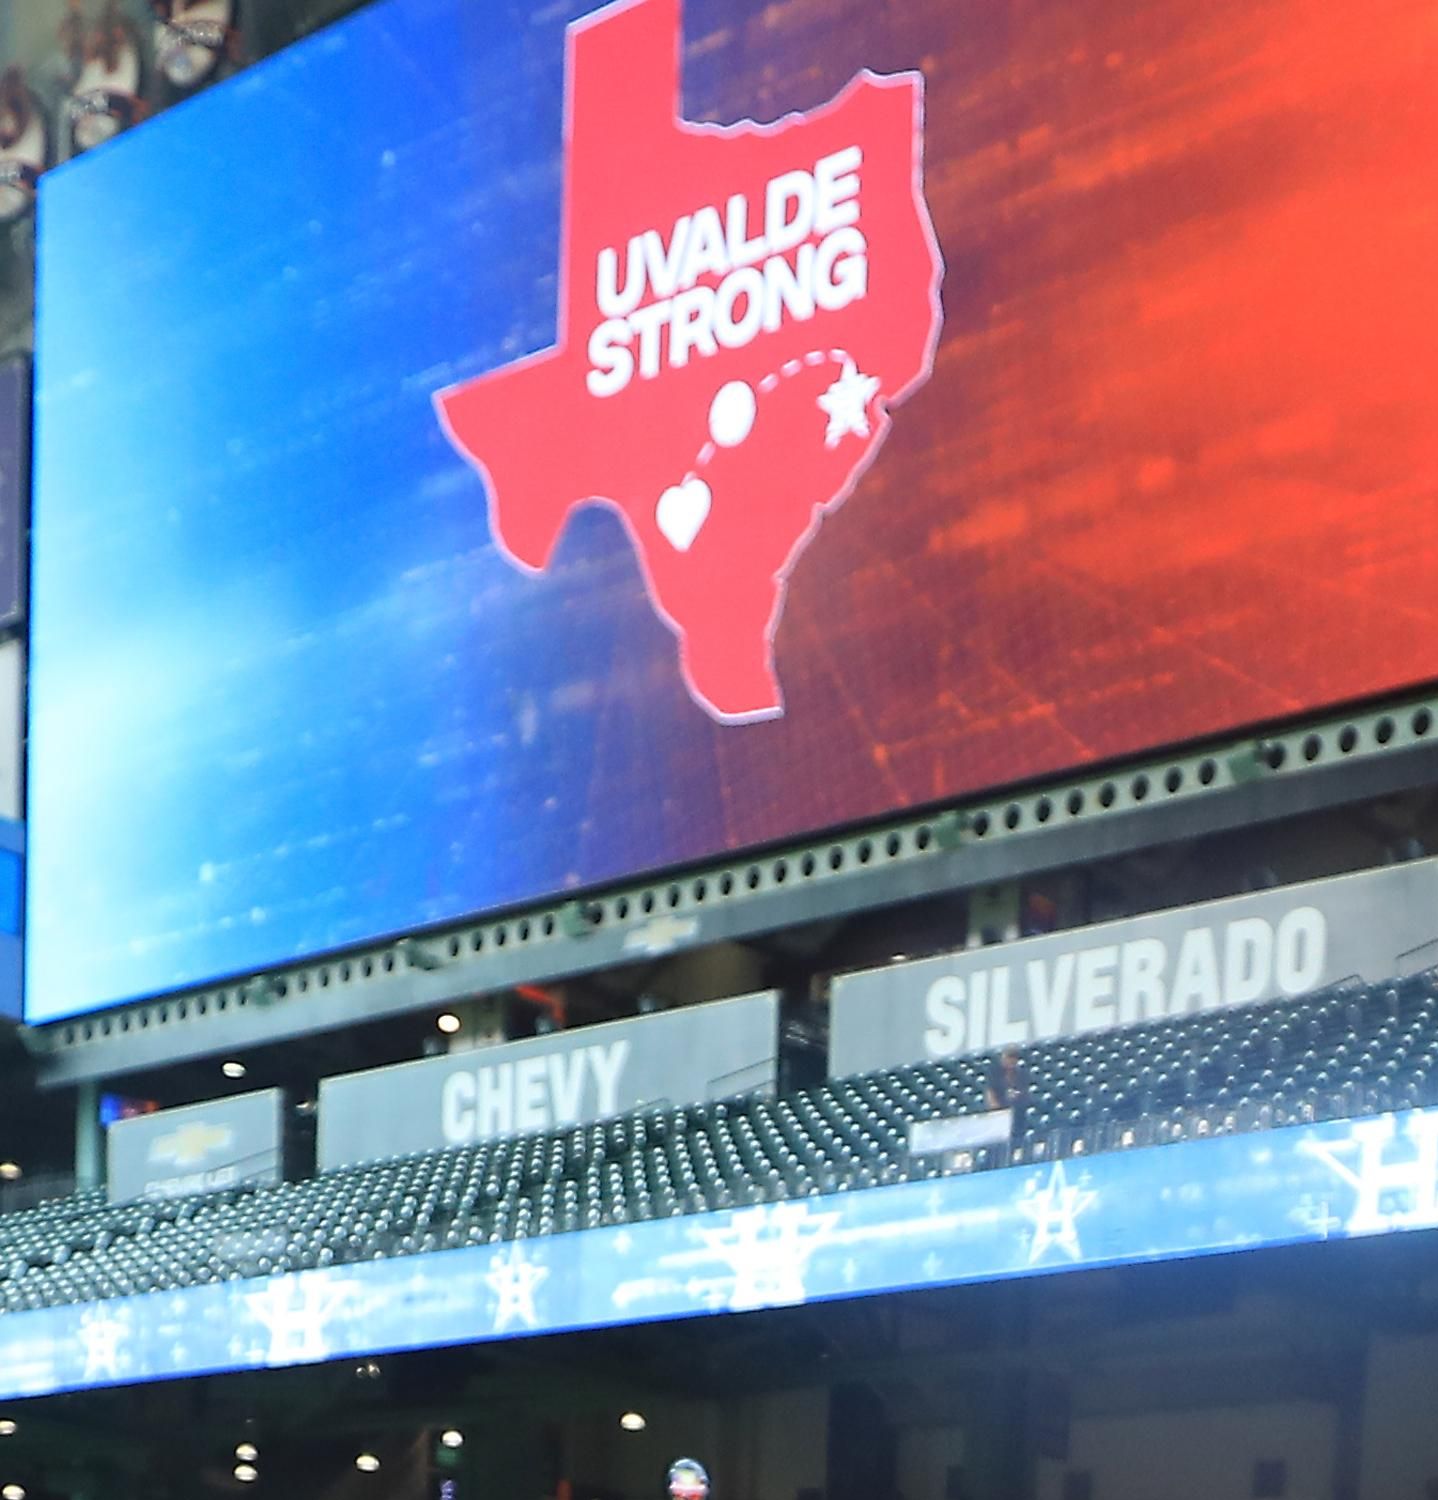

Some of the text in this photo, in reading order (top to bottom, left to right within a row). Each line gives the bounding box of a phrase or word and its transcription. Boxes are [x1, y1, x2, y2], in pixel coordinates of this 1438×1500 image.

[586, 226, 868, 398] STRONG
[595, 144, 864, 319] UVALDE
[924, 905, 1328, 1057] SILVERADO
[440, 1039, 631, 1142] CHEVY
